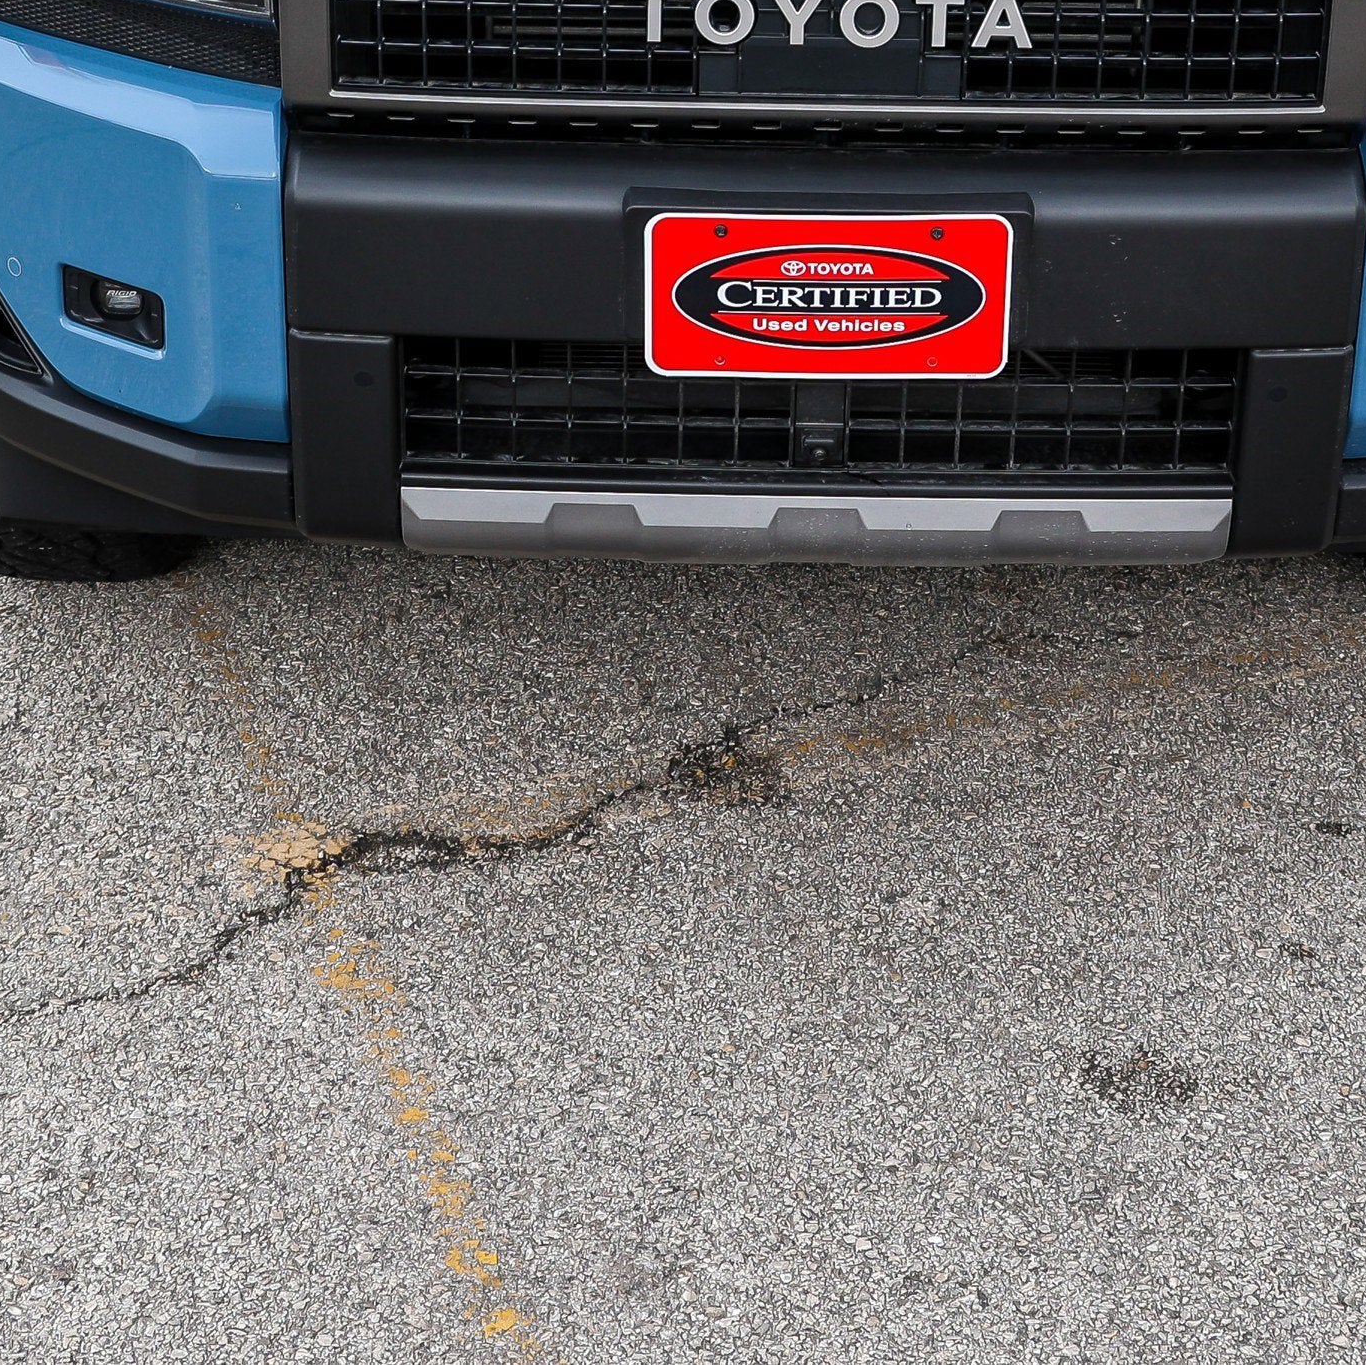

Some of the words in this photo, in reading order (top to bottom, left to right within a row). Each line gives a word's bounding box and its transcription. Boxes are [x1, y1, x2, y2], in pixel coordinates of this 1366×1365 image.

[807, 261, 875, 276] TOYOTA
[106, 289, 138, 297] RIGID
[716, 281, 943, 309] CERTIFIED
[751, 316, 808, 333] Used
[813, 317, 906, 333] Vehicles
